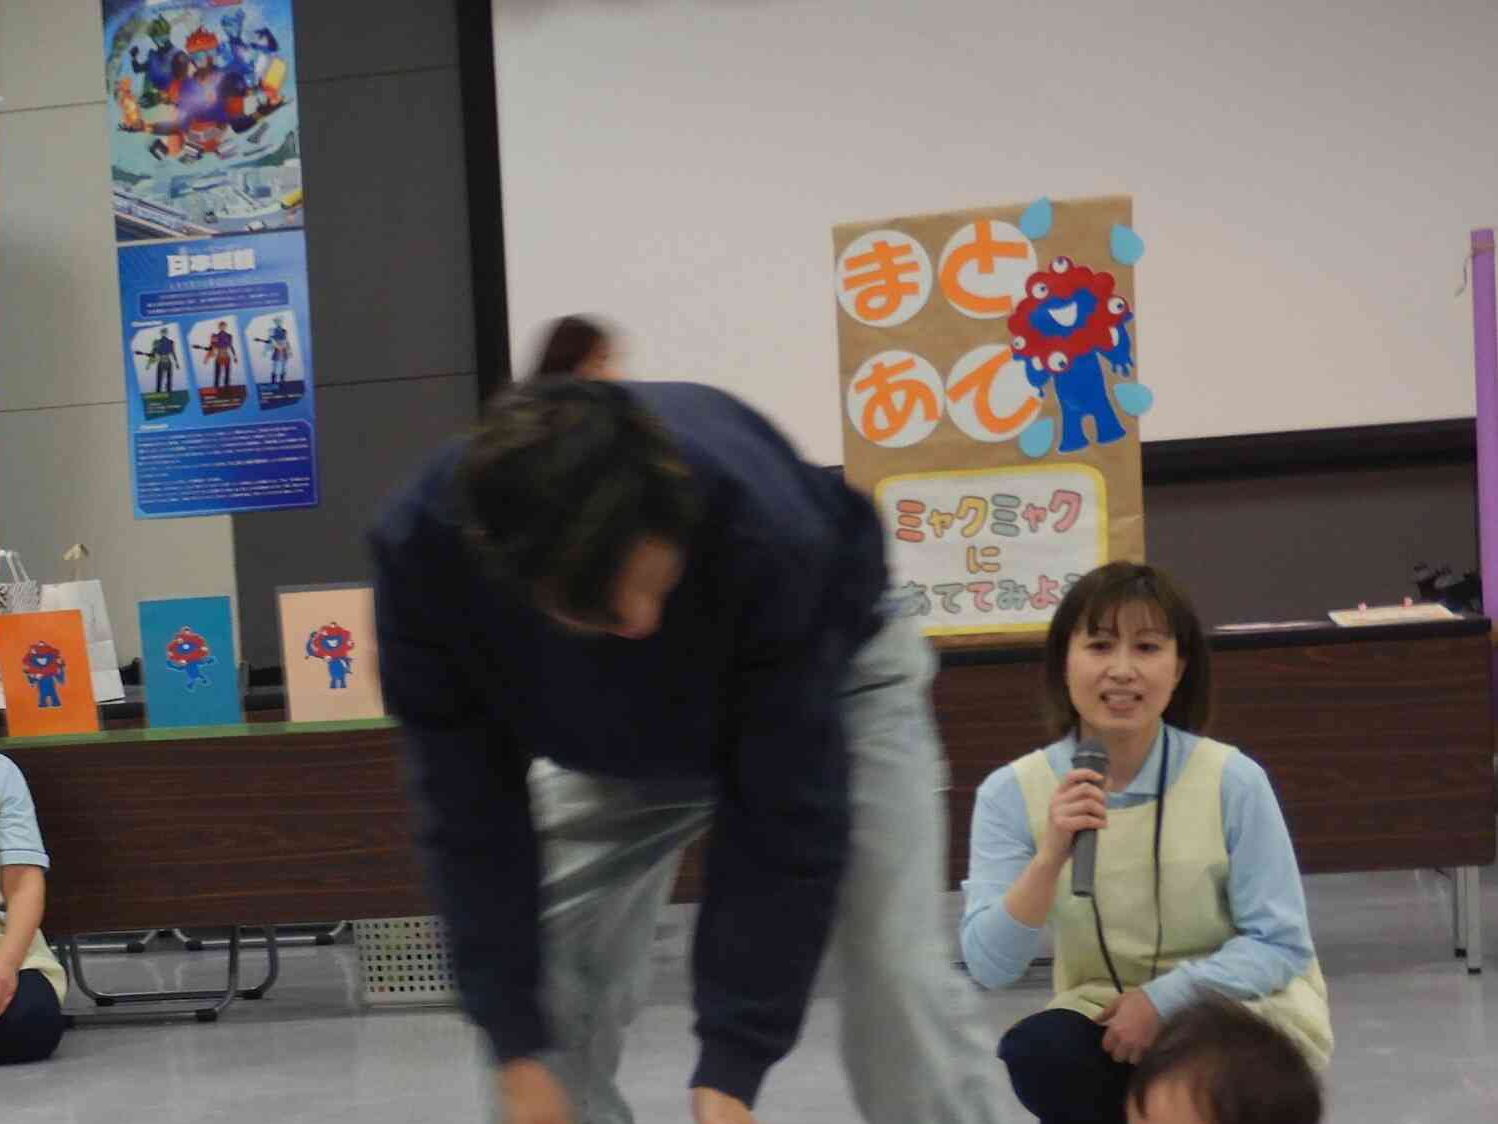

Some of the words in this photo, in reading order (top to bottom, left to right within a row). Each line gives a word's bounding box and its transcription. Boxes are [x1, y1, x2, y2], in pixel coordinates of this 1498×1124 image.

[843, 217, 1029, 322] まと
[853, 349, 1042, 443] あて
[895, 489, 1082, 543] ミャクミャク
[966, 545, 1001, 574] に
